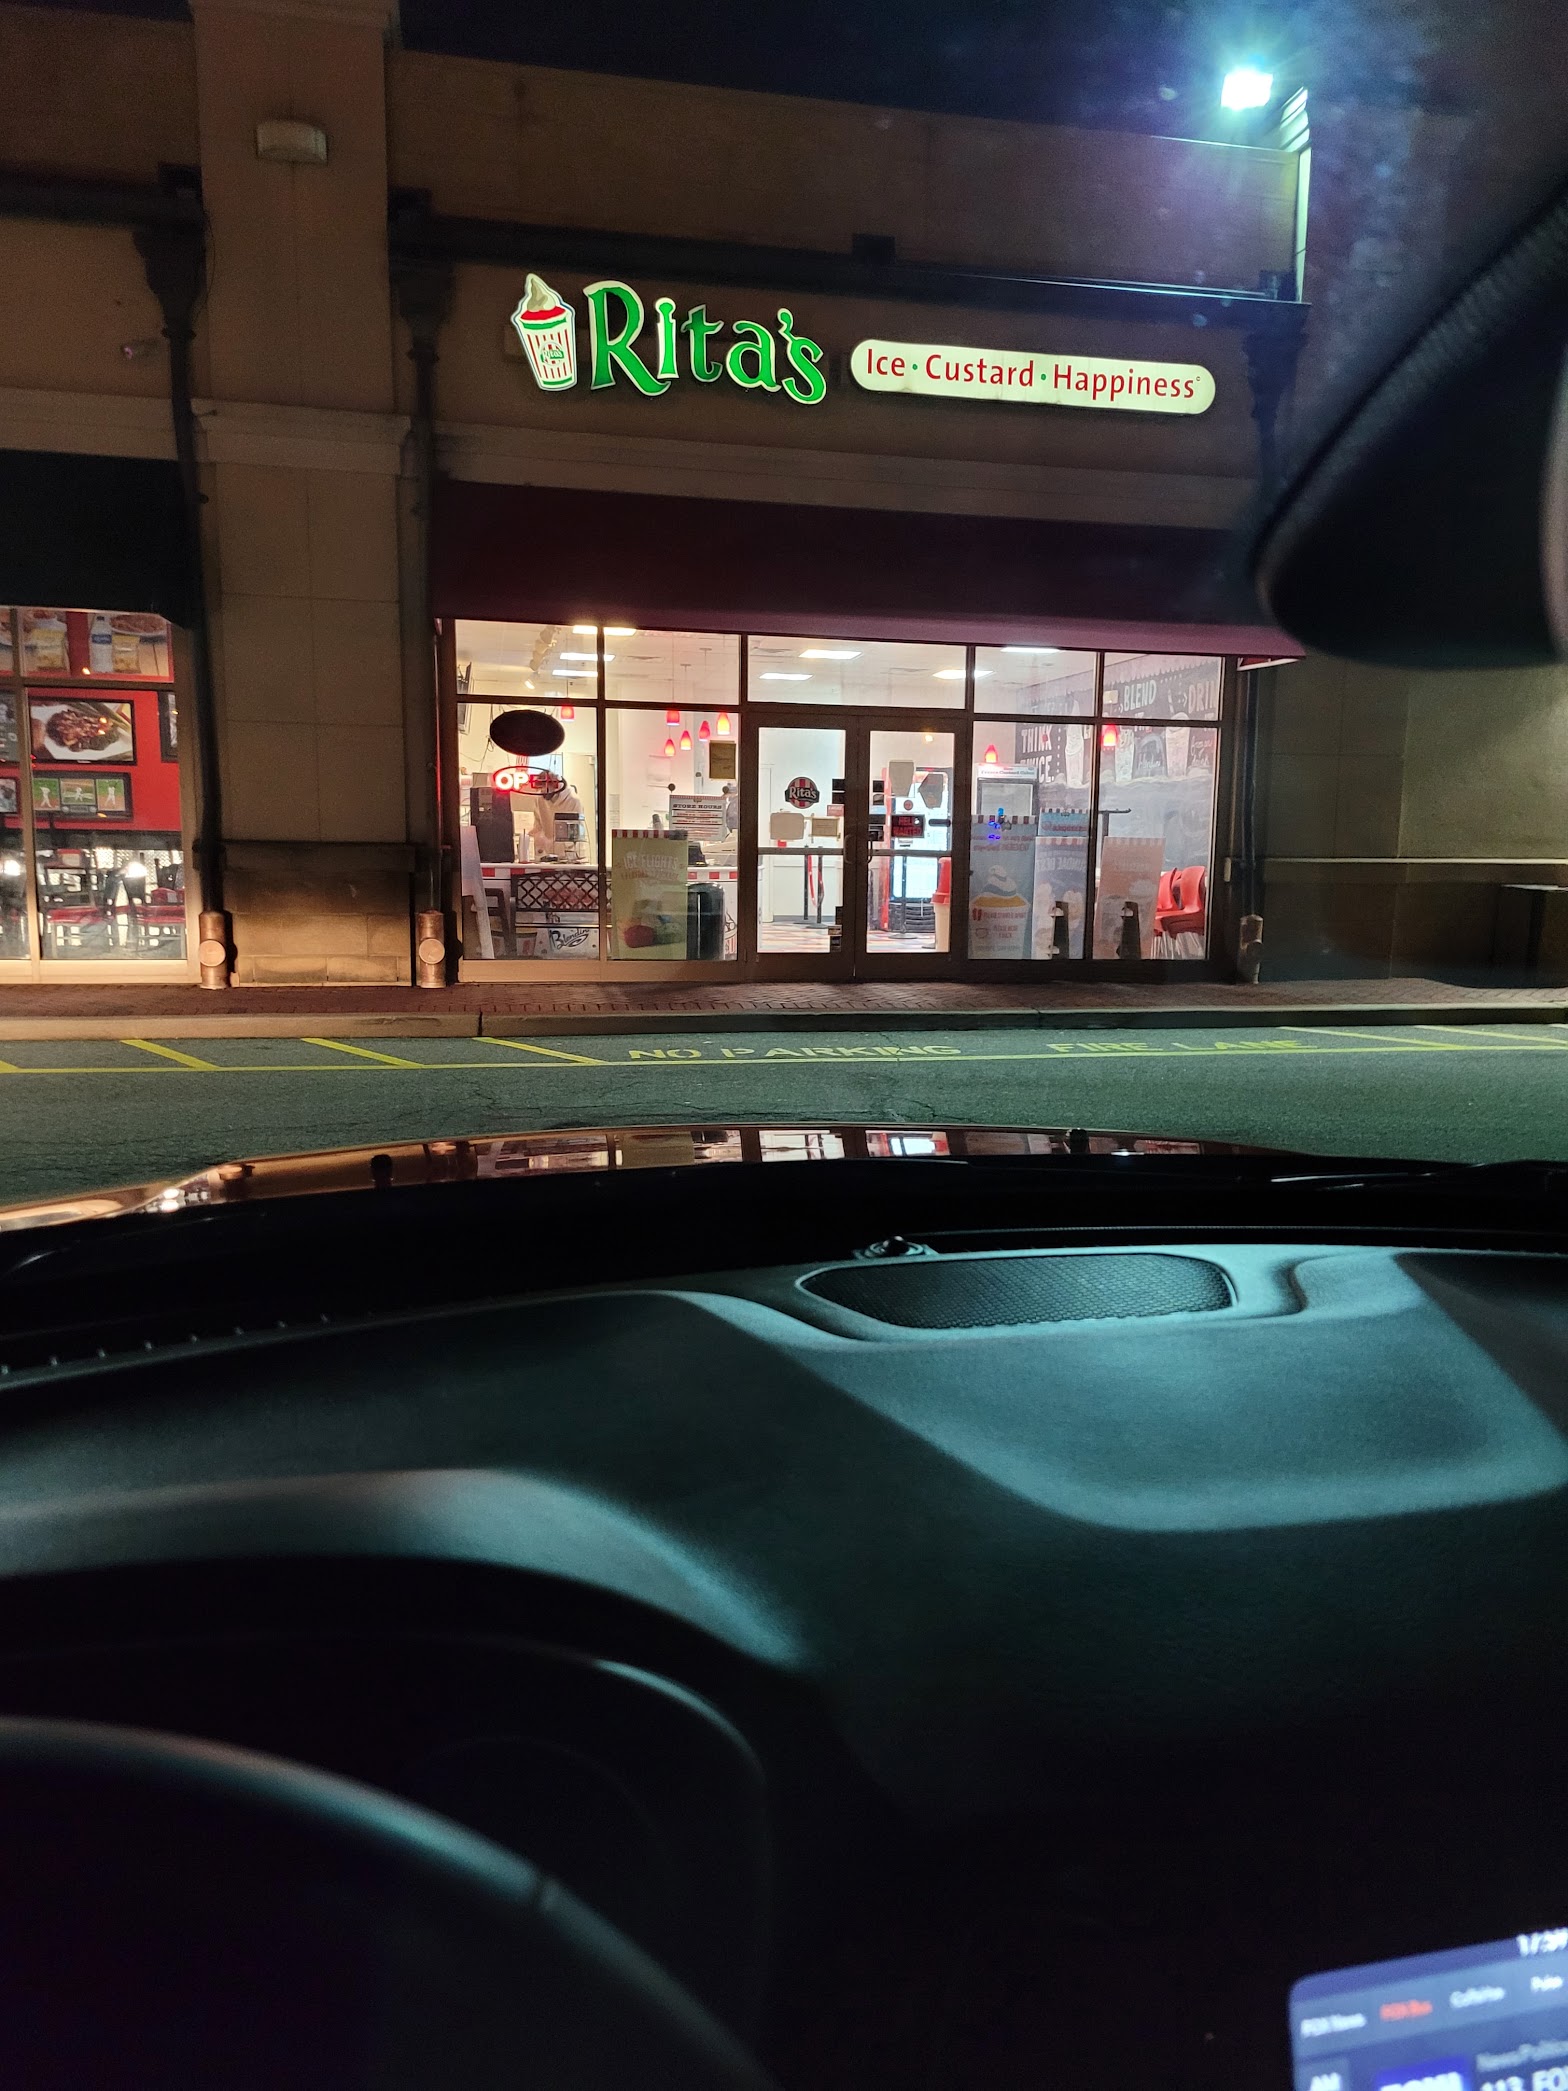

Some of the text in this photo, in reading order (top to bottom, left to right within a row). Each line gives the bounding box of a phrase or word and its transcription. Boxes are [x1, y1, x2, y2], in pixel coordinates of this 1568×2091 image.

[583, 280, 827, 404] Rita's
[867, 348, 1194, 402] Ice Custard Happiness
[1123, 679, 1157, 712] BLEND
[789, 786, 817, 799] Rita's
[628, 1039, 1318, 1059] NO PARKING FIRE LANE
